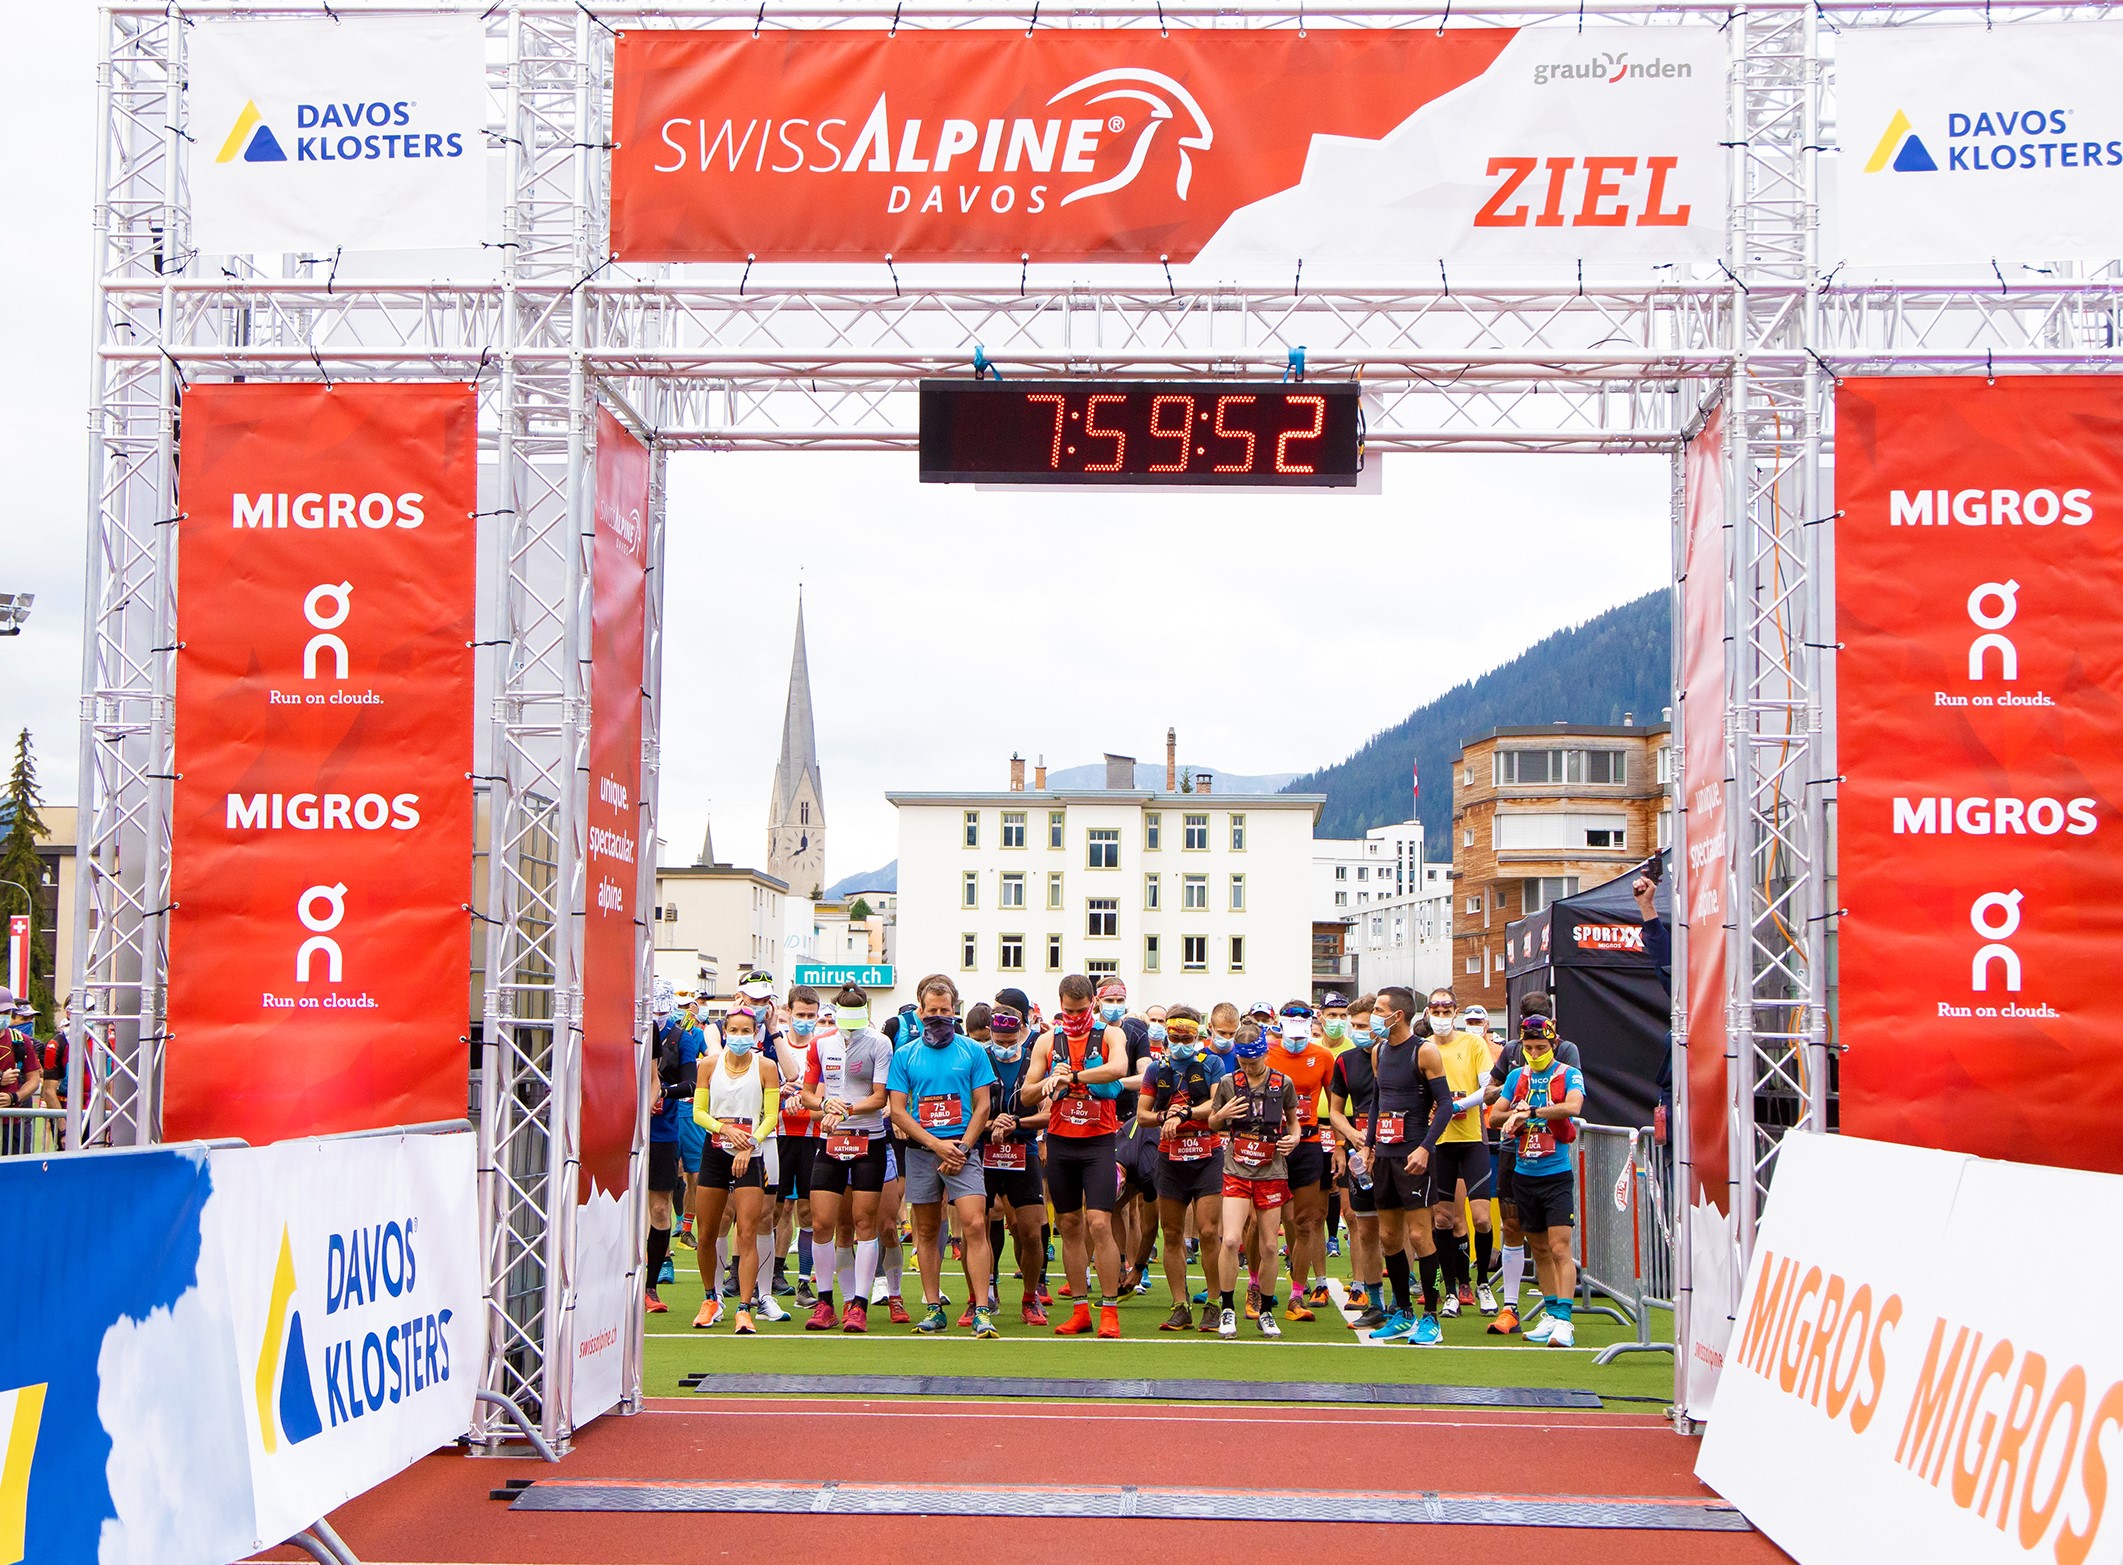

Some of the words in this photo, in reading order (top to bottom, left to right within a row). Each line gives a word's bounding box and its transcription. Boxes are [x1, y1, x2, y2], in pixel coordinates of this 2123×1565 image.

[297, 132, 464, 162] KLOSTERS
[1949, 140, 2123, 171] KLOSTERS
[887, 184, 1048, 214] DAVOS
[1472, 156, 1692, 228] ZIEL
[232, 492, 425, 529] MIGROS
[1889, 488, 2093, 526] MIGROS
[270, 691, 302, 704] Run
[305, 694, 325, 704] on
[329, 689, 385, 705] clouds.
[1934, 693, 1968, 706] Run
[1971, 696, 1992, 706] on
[1996, 691, 2056, 707] clouds.
[600, 772, 629, 816] unique.
[226, 792, 421, 830] MIGROS
[1893, 796, 2098, 836] MIGROS
[589, 825, 635, 864] spectacular.
[598, 875, 624, 918] alpine.
[804, 966, 882, 985] mirus.ch
[262, 994, 295, 1007] Run
[298, 997, 319, 1007] on
[322, 991, 379, 1008] clouds.
[1937, 1003, 1971, 1017] Run
[1975, 1006, 1996, 1017] on
[2001, 1001, 2060, 1018] clouds.
[933, 1103, 946, 1111] 75
[1076, 1101, 1083, 1110] 9
[1381, 1119, 1392, 1128] 101
[843, 1138, 849, 1146] 4
[1181, 1138, 1199, 1147] 104
[1320, 1131, 1331, 1139] 36
[1529, 1134, 1539, 1142] 21
[999, 1144, 1011, 1153] 30
[1240, 1149, 1266, 1157] VERONIKA
[1247, 1141, 1259, 1150] 47
[1737, 1250, 1903, 1435] MIGROS
[325, 1308, 453, 1428] KLOSTERS
[1894, 1316, 2123, 1565] MIGROS
